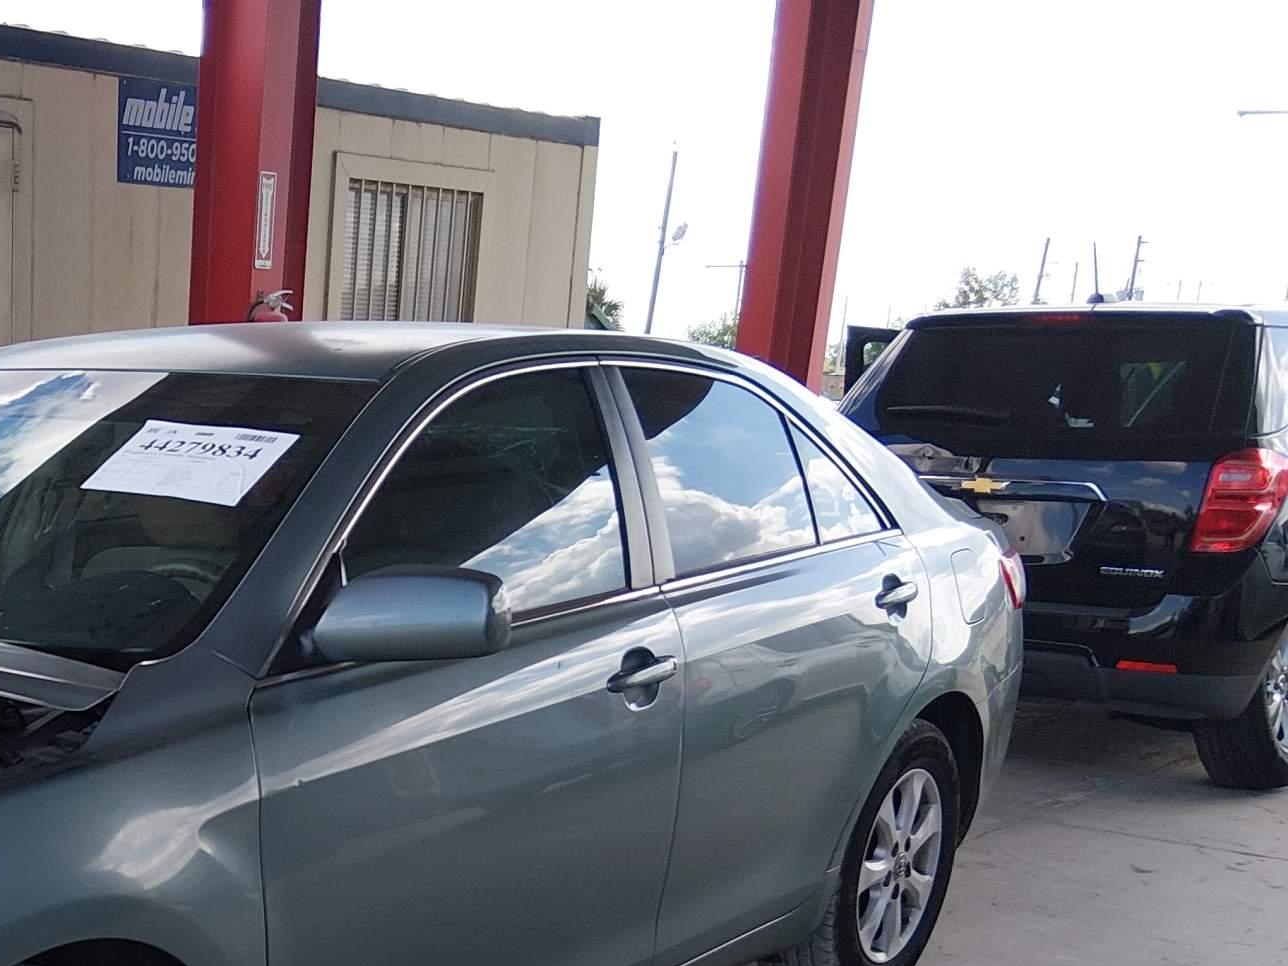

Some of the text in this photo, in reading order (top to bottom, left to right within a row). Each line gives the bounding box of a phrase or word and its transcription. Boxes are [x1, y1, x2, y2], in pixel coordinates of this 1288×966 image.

[122, 87, 195, 133] mobile
[127, 137, 196, 163] 1-800-950
[139, 438, 263, 460] 44279834
